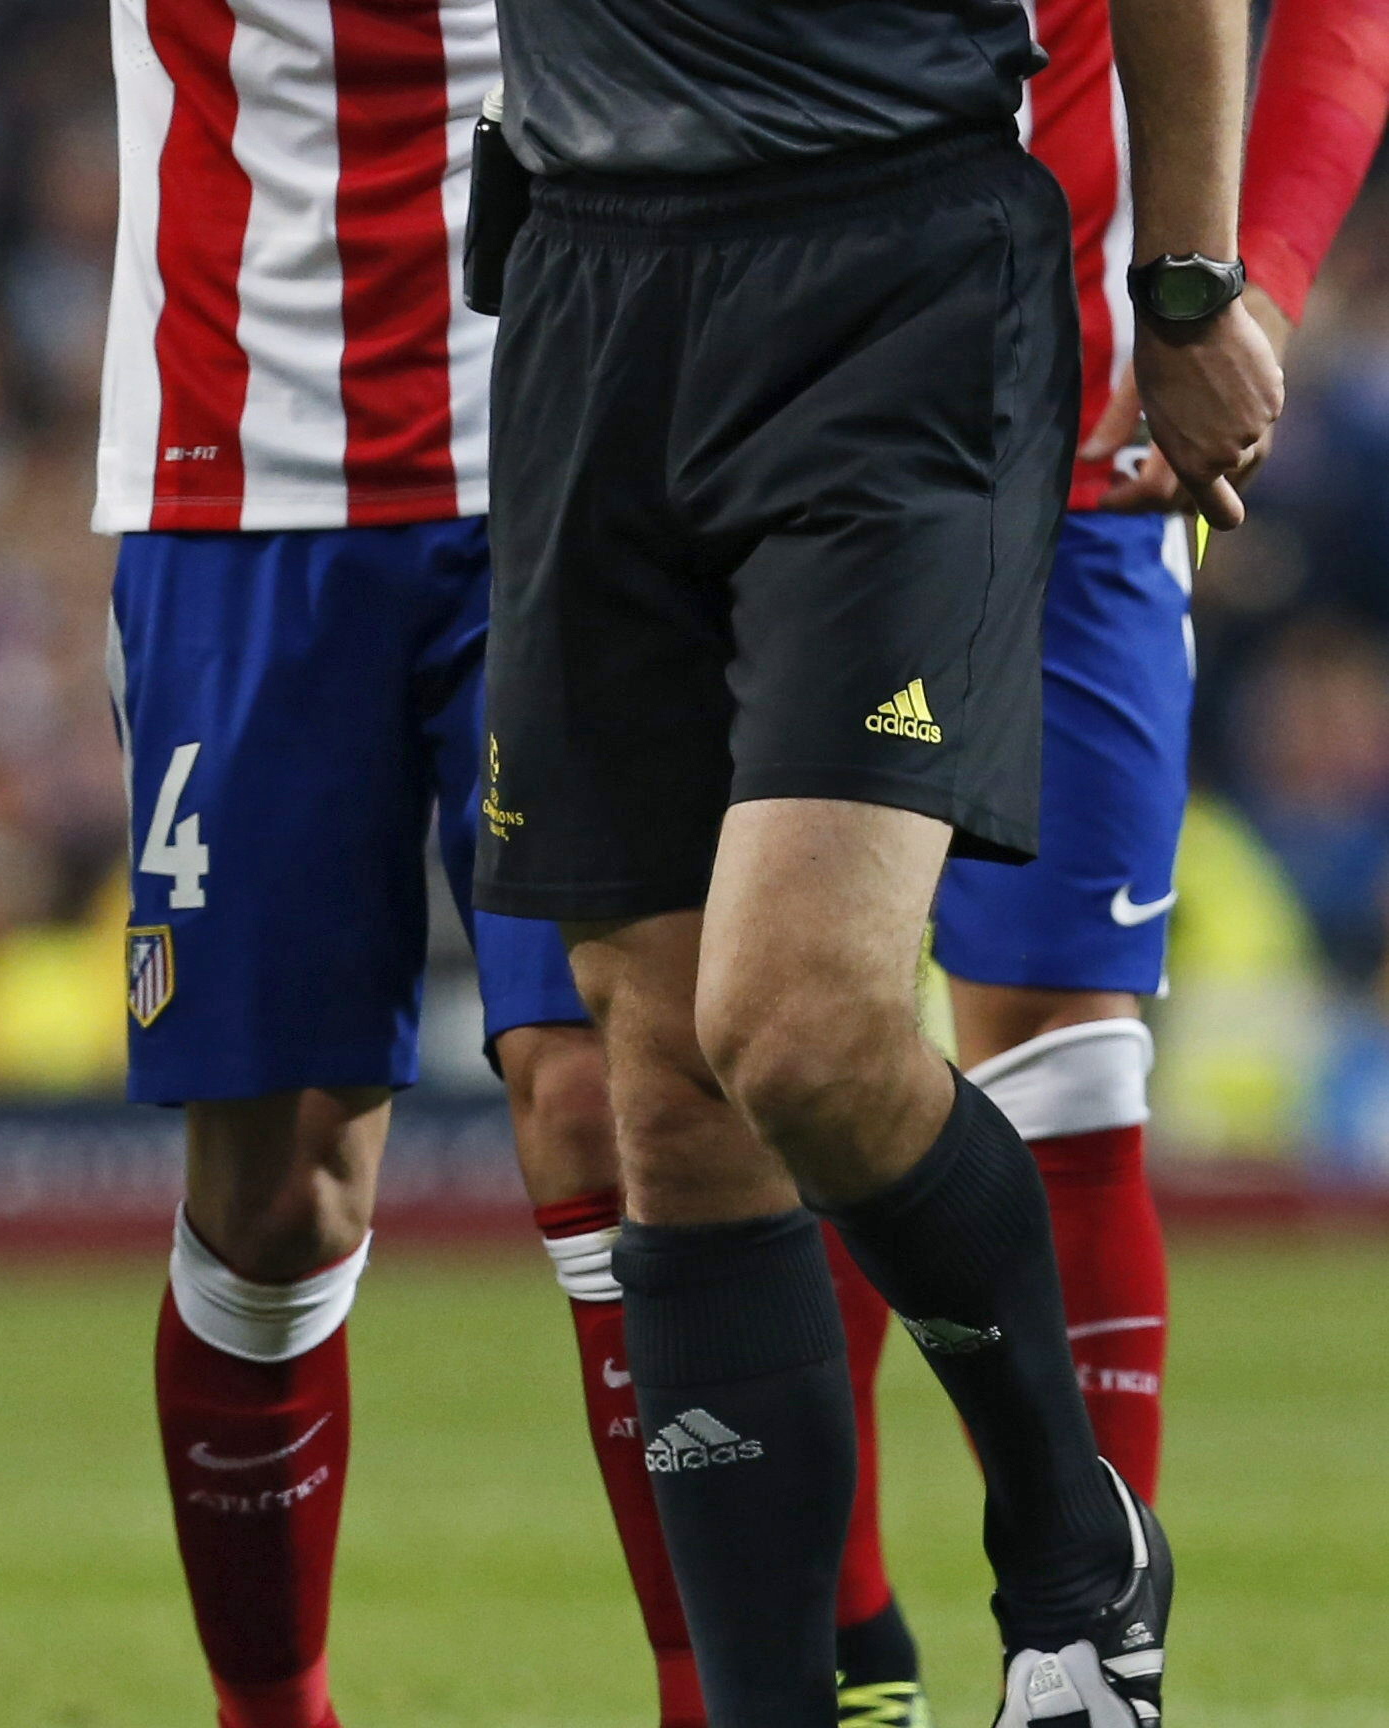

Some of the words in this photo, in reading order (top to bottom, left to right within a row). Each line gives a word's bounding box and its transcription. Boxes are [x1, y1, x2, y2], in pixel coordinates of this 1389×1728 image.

[865, 713, 943, 744] adidas
[139, 742, 209, 910] 4
[645, 1438, 763, 1472] adidas
